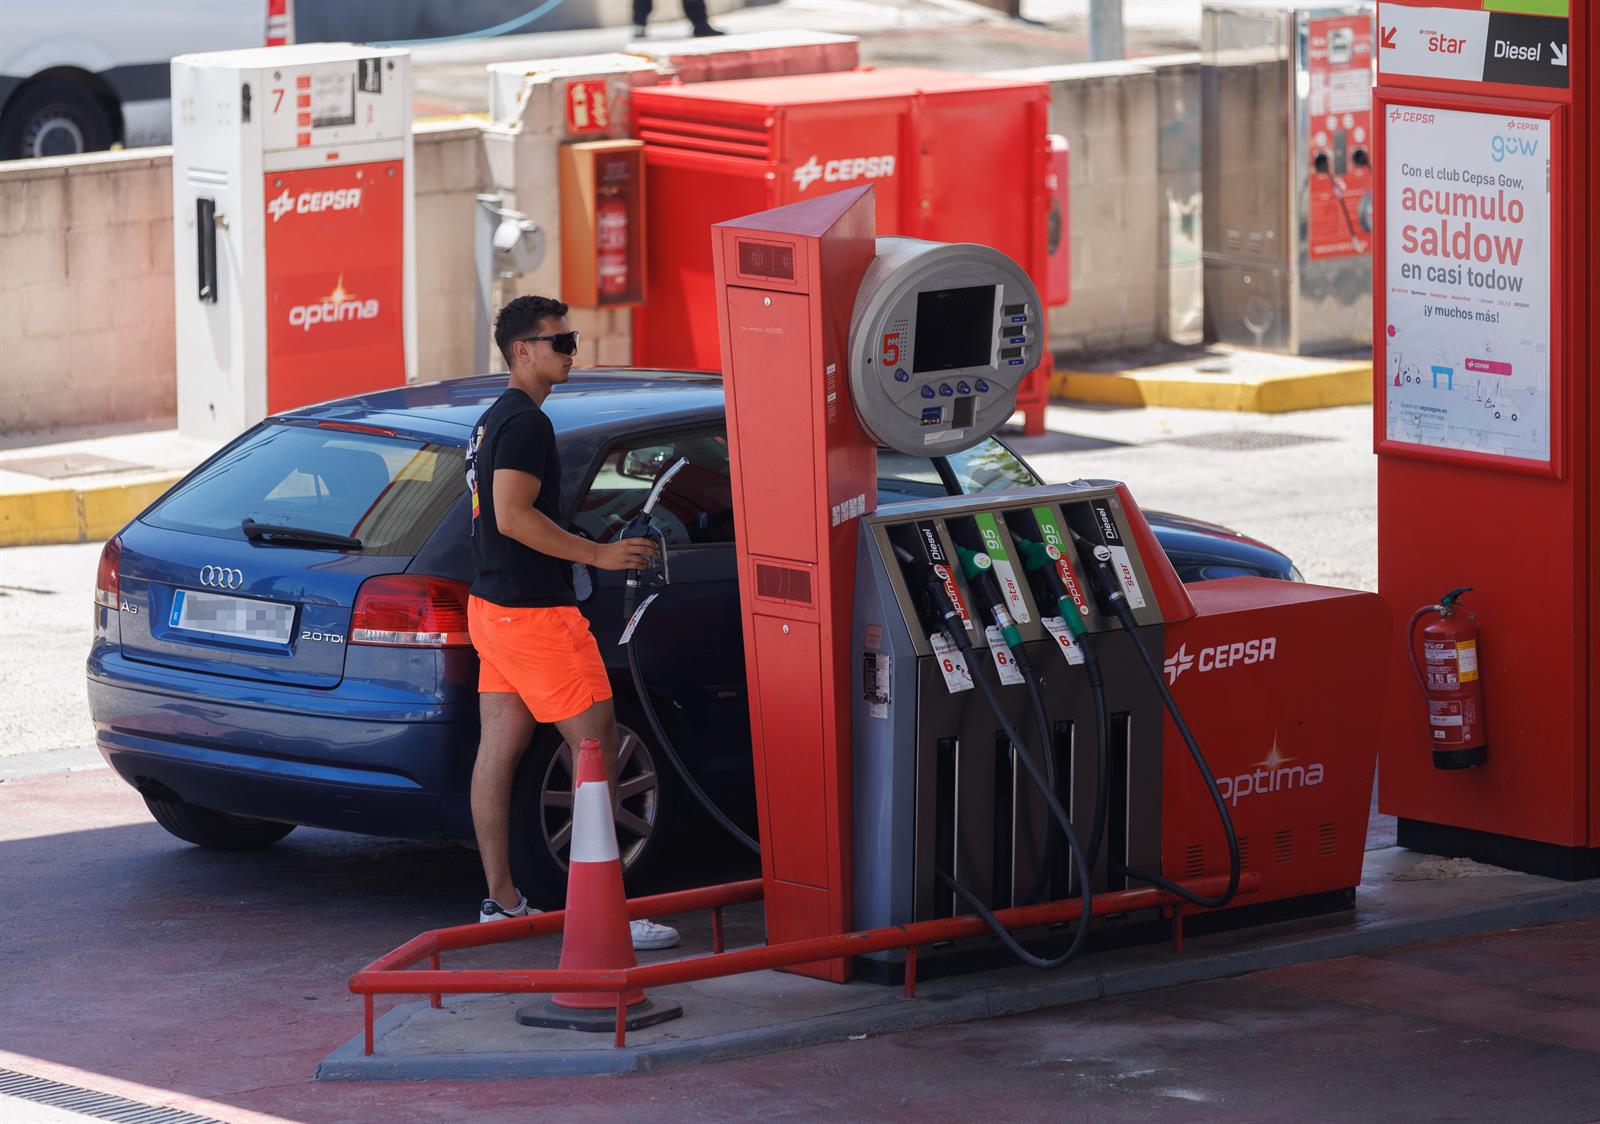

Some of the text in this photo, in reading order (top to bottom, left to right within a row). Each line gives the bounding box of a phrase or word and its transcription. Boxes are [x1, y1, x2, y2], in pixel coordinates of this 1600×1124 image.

[1428, 33, 1466, 54] star
[1493, 40, 1541, 62] Diesel
[271, 89, 285, 113] 7
[1403, 111, 1435, 125] CEPSA
[1516, 122, 1539, 131] CEPSA
[824, 155, 896, 182] CEPSA
[1401, 163, 1525, 190] Con el club Cepsa Gow,
[296, 188, 362, 214] CEPSA
[1401, 187, 1524, 223] acumulo
[1401, 219, 1523, 266] saldow
[1401, 262, 1523, 293] en casi todow
[289, 299, 380, 331] optima
[1435, 305, 1473, 320] muchos
[1475, 309, 1500, 323] más!
[882, 332, 901, 367] 5
[1041, 524, 1059, 545] 95
[1096, 507, 1115, 539] Diesel
[922, 528, 941, 560] Diesel
[982, 529, 1000, 550] 95
[1060, 559, 1081, 605] optima
[1120, 563, 1135, 588] star
[1004, 576, 1020, 601] star
[121, 599, 138, 614] A3
[301, 631, 344, 643] 2.0 TDI
[1058, 635, 1071, 647] 6
[943, 658, 954, 673] 6
[996, 651, 1007, 665] 6
[1198, 636, 1277, 673] CEPSA
[1215, 763, 1324, 808] optima
